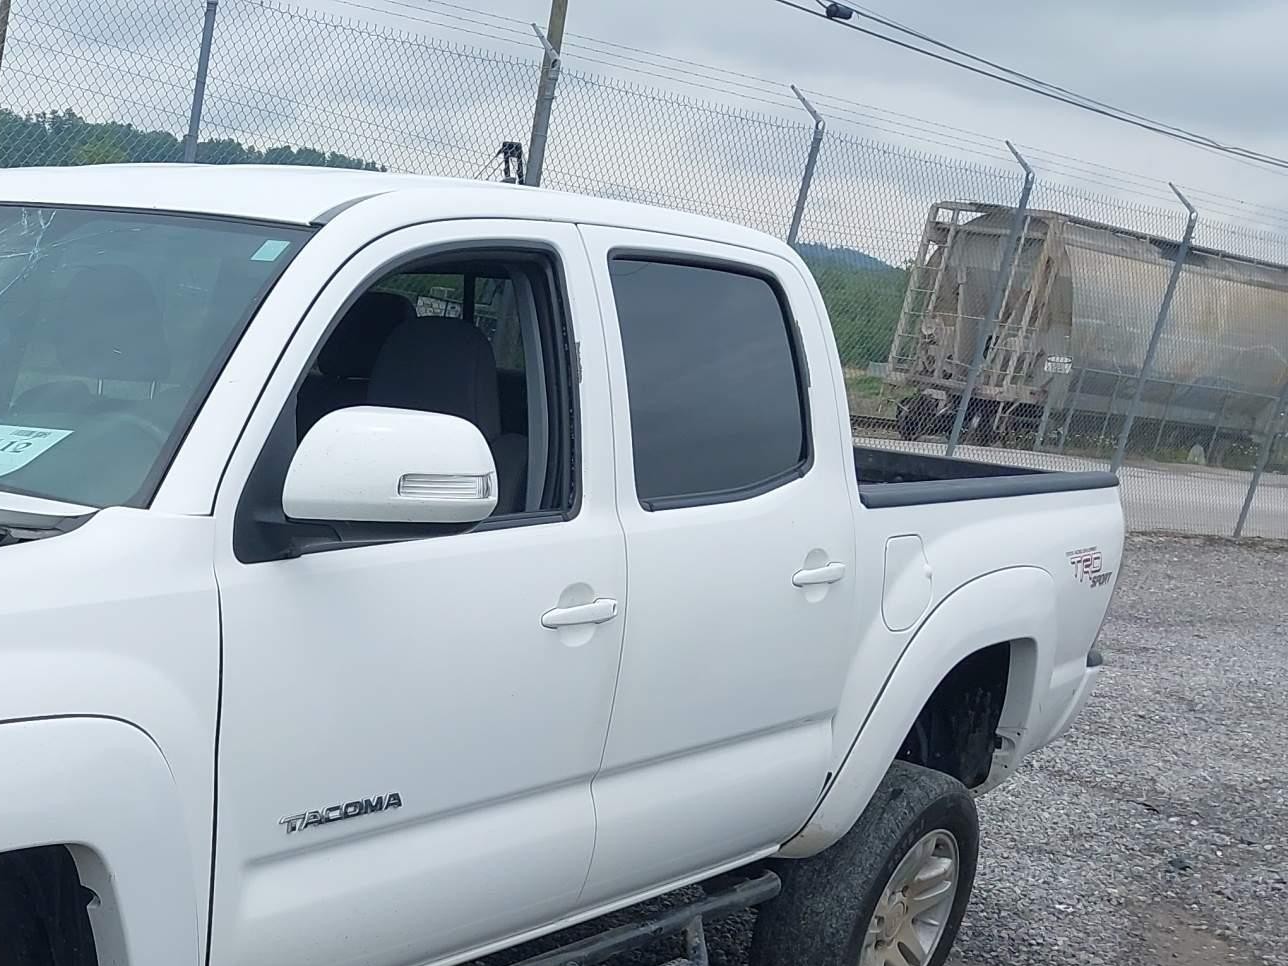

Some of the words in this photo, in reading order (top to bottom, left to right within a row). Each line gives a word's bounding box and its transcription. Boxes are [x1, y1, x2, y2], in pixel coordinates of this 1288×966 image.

[1070, 552, 1103, 582] TRD
[1090, 571, 1113, 588] SPORT
[279, 792, 403, 834] TACOMA
